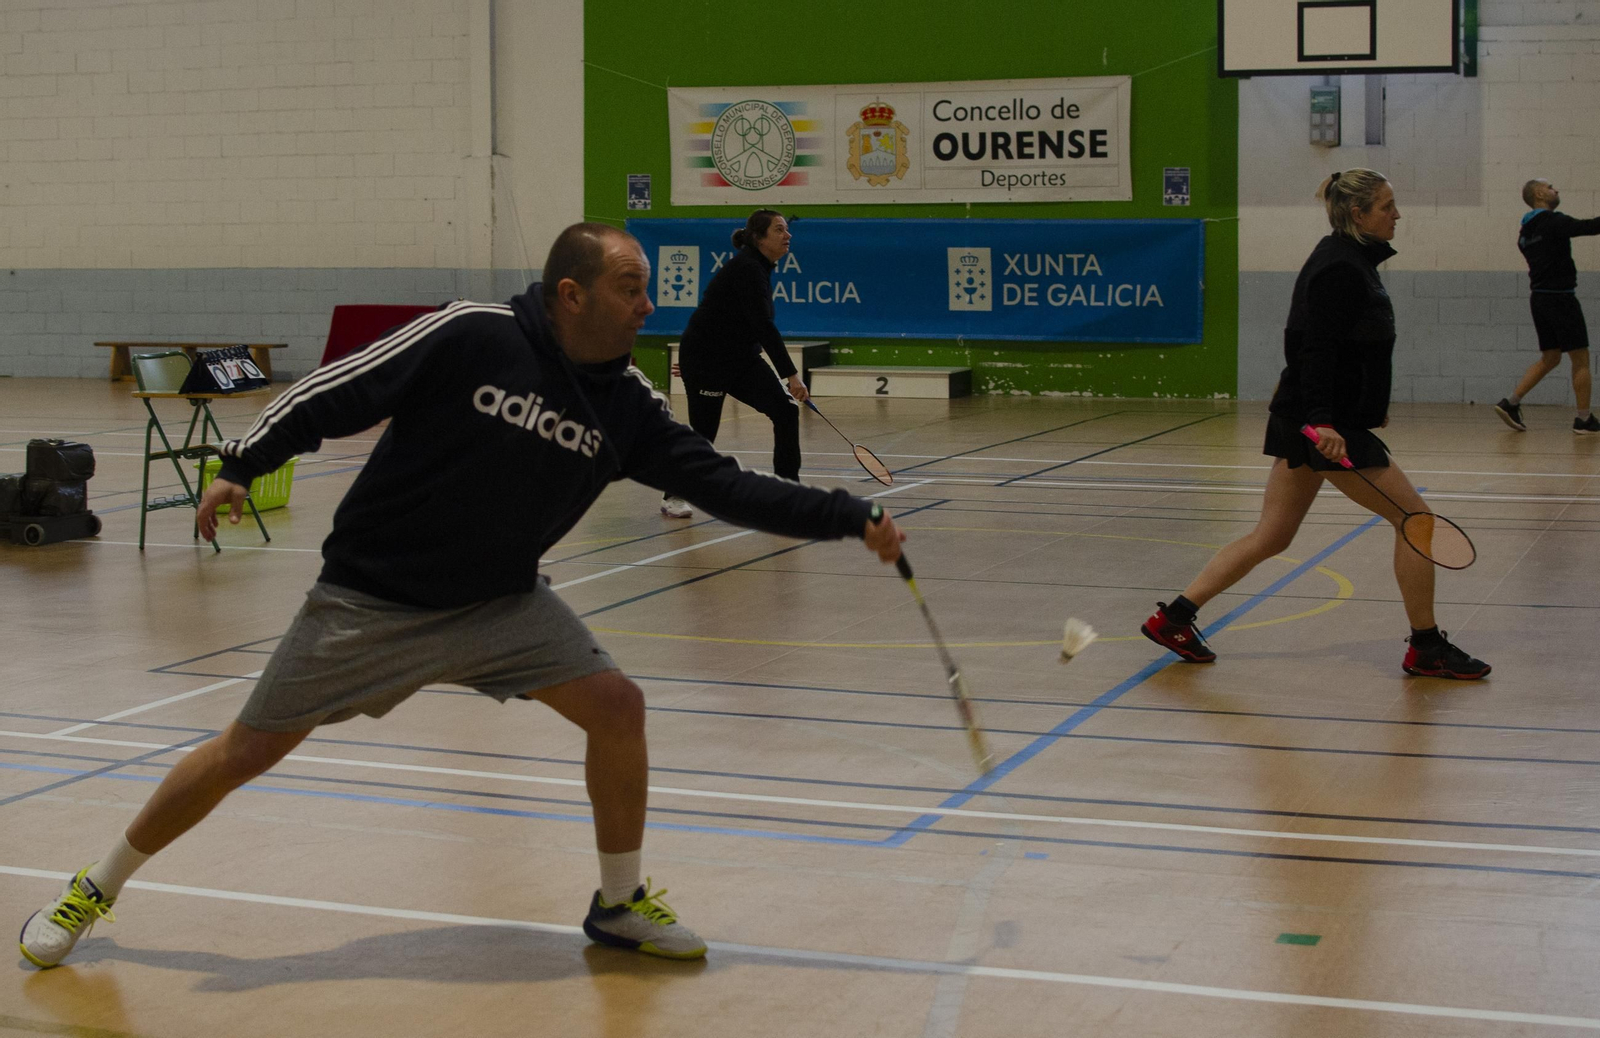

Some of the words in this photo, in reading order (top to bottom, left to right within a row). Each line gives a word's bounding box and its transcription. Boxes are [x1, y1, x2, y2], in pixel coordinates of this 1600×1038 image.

[722, 103, 769, 125] MUNICIPAL
[770, 110, 784, 124] DE
[933, 98, 1041, 122] Concello
[1051, 97, 1080, 119] de
[714, 124, 733, 177] CONSELLO
[777, 123, 793, 176] DEPORTES
[933, 129, 1108, 161] OURENSE
[732, 173, 777, 188] OURENSE
[981, 170, 1066, 191] Deportes
[1003, 253, 1103, 276] XUNTA
[772, 281, 861, 304] ALICIA
[1002, 283, 1039, 306] DE
[1046, 283, 1164, 307] GALICIA
[876, 376, 889, 394] 2
[472, 384, 603, 458] adidas
